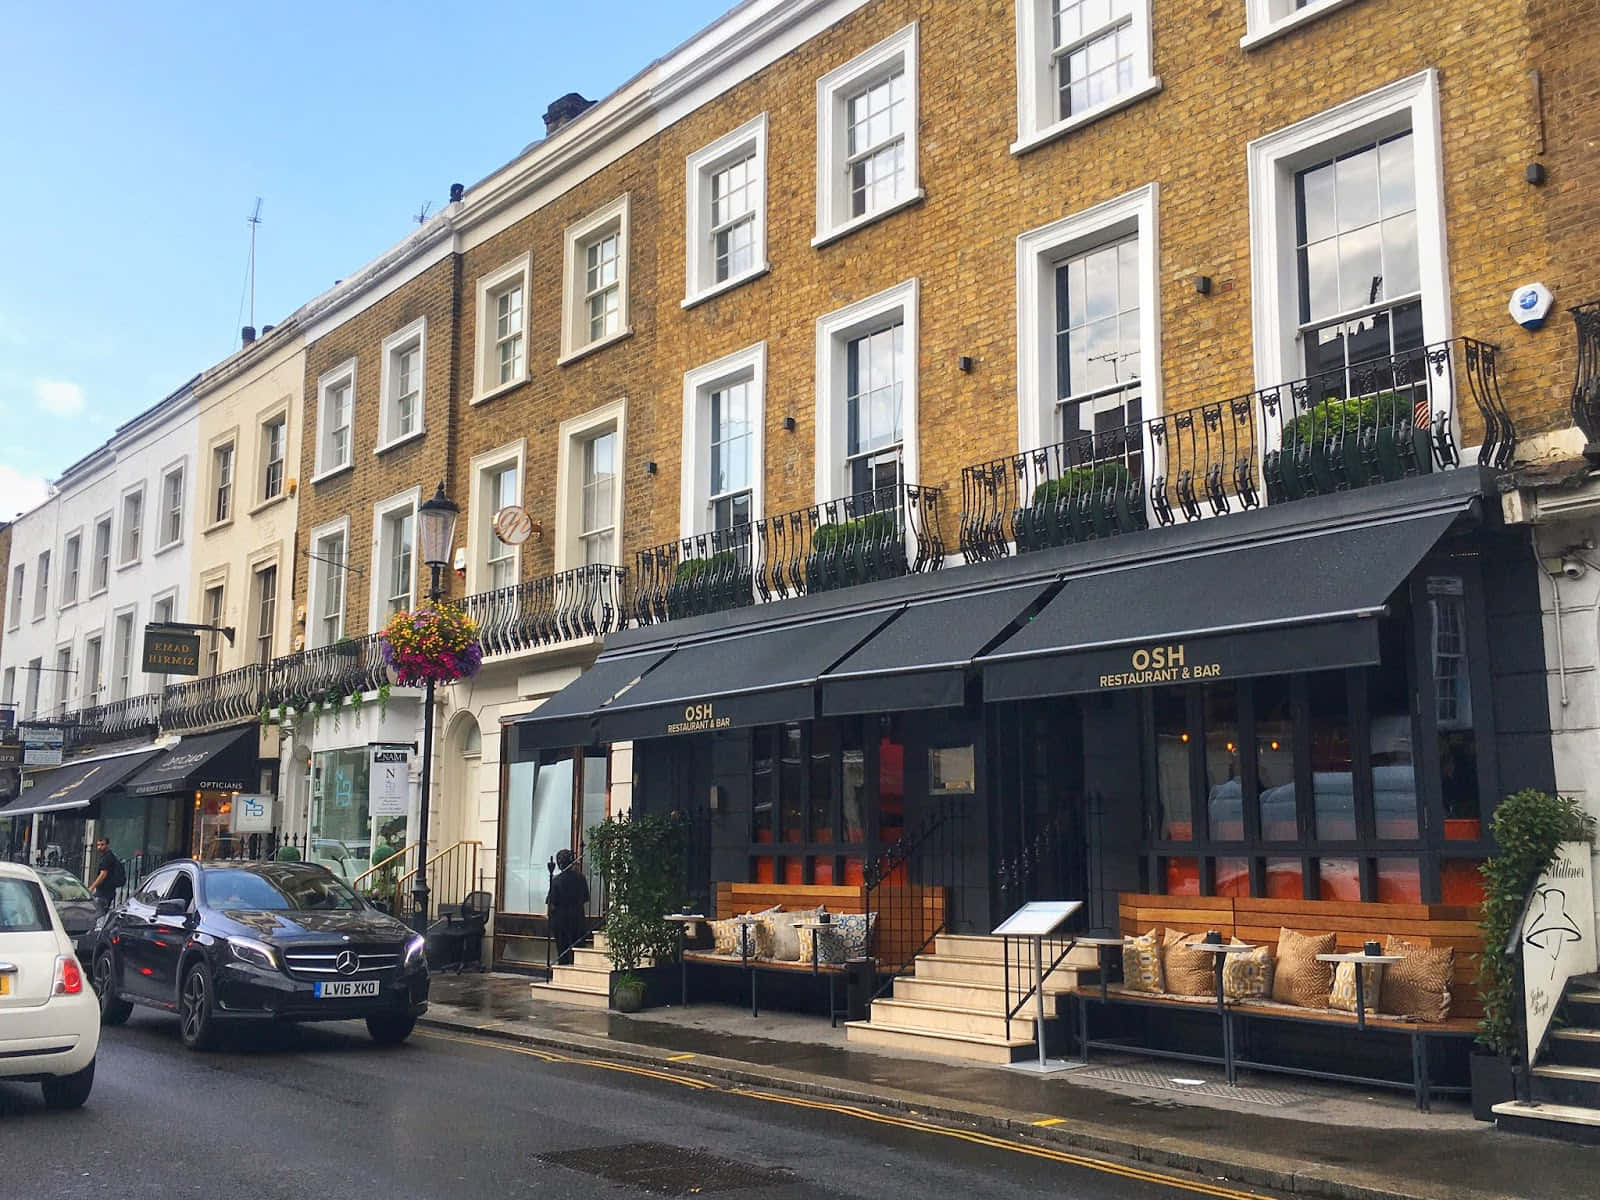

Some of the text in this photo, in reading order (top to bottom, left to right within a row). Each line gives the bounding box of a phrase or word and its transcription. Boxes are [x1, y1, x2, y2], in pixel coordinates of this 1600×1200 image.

[1131, 644, 1185, 671] OSH
[1099, 663, 1221, 688] RESTAURANT & BAR
[684, 703, 713, 722] OSH
[667, 719, 709, 734] RESTAURANT
[715, 717, 731, 729] BAR
[200, 780, 244, 790] OPTICIANS
[325, 982, 375, 996] LV16 XKO
